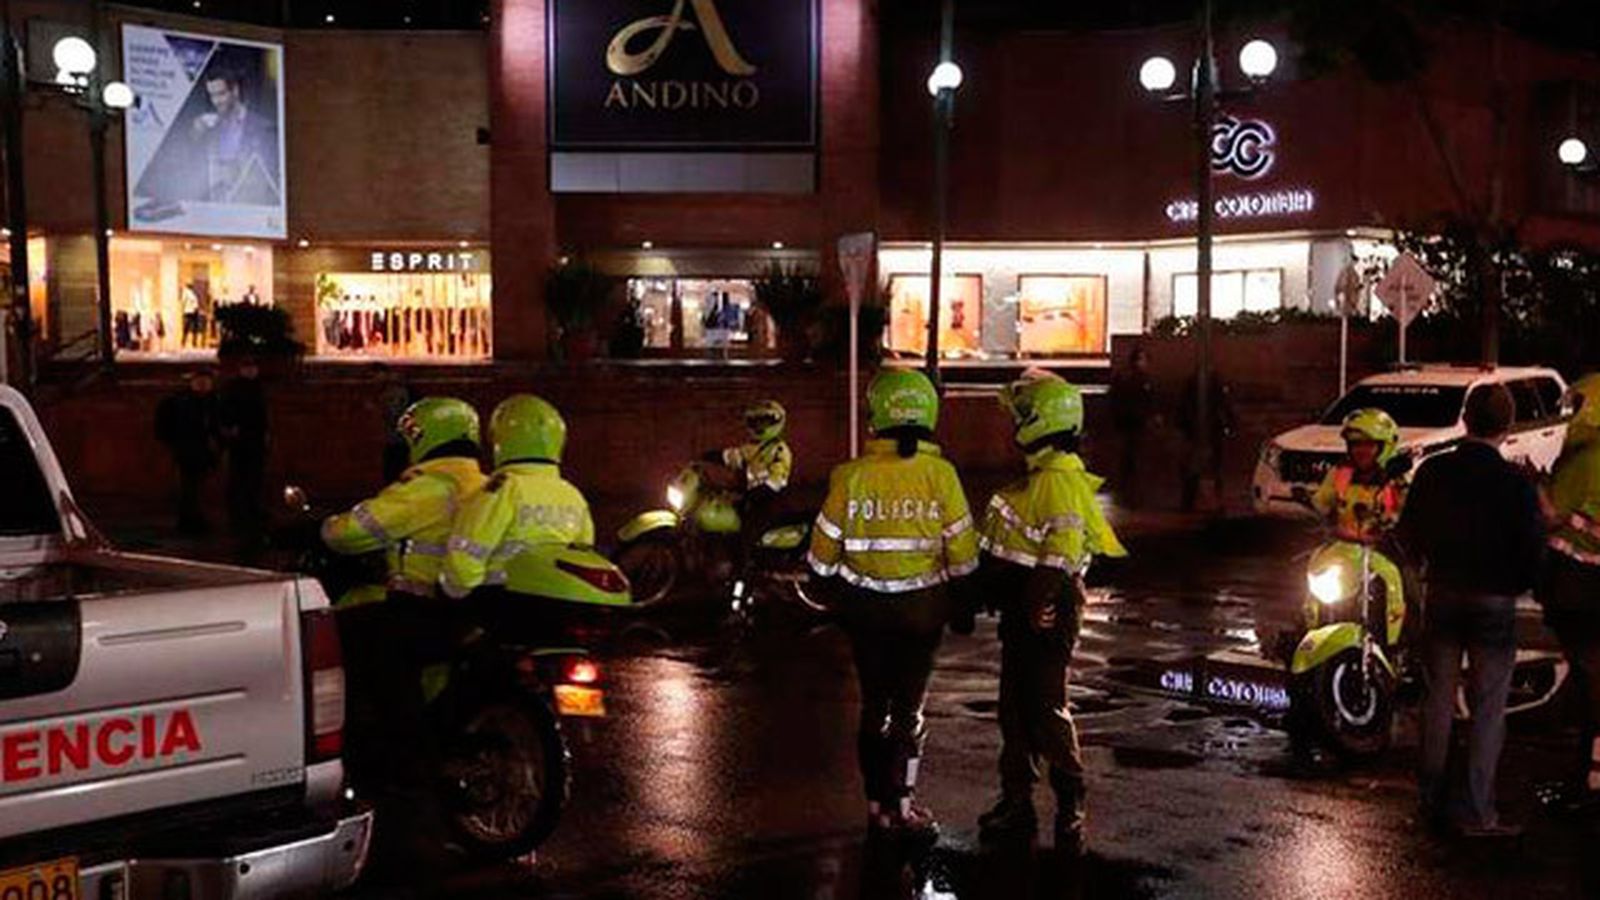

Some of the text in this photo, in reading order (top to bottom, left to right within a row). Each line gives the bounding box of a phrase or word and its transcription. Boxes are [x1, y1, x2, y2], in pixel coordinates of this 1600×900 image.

[604, 81, 760, 108] ANDINO
[371, 252, 473, 271] ESPRIT
[848, 499, 941, 520] POLICIA
[2, 706, 202, 783] ENCIA
